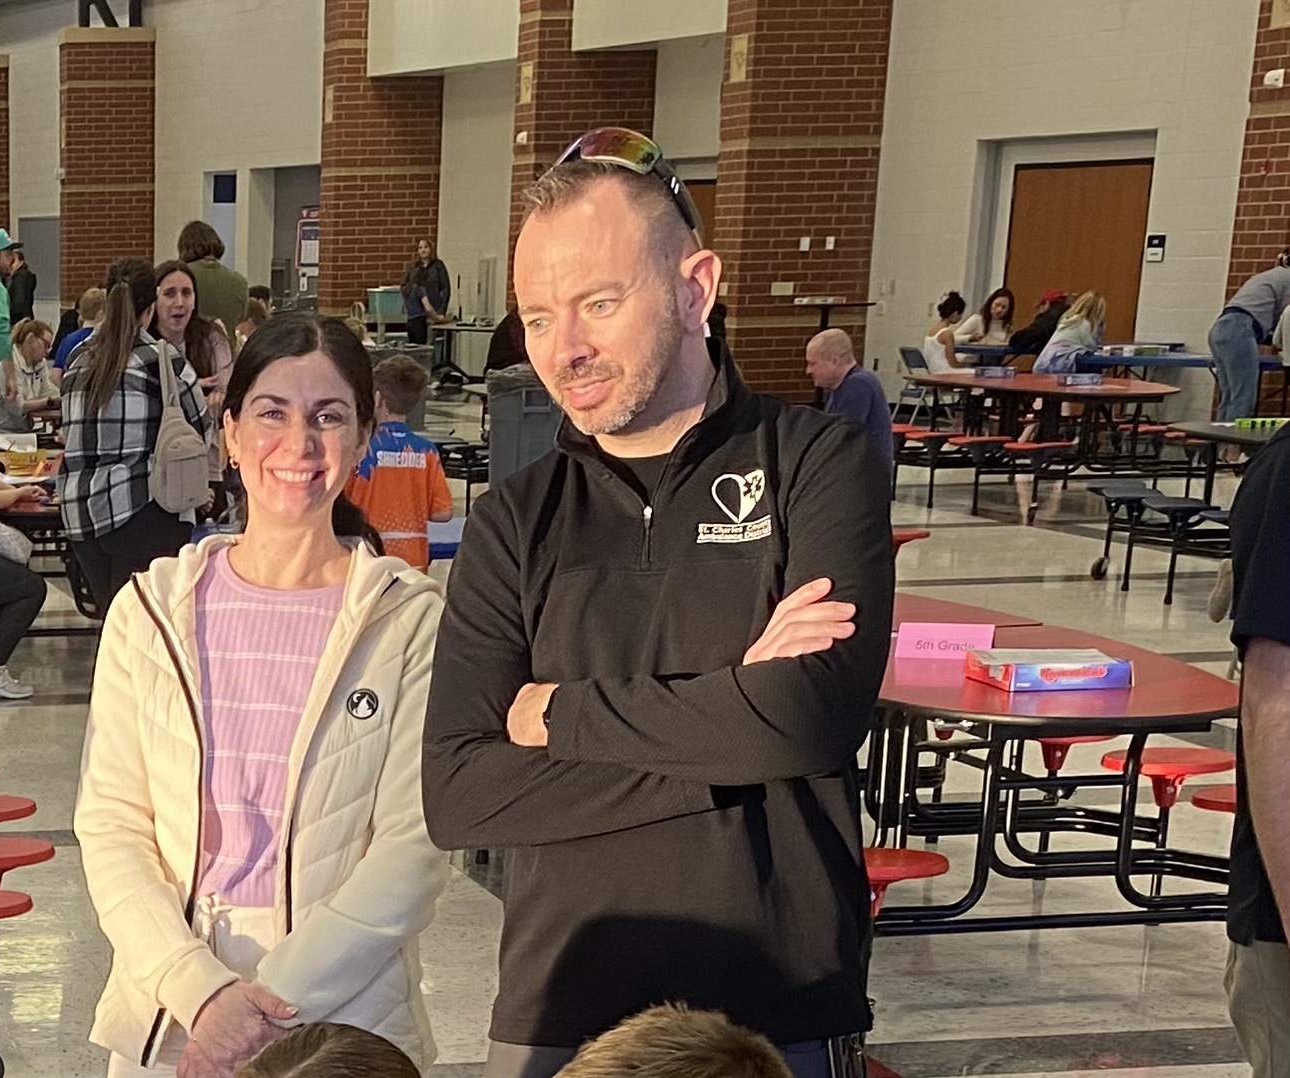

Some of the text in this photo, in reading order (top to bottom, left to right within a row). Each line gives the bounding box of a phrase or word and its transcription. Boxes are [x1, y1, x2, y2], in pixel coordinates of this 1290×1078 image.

[376, 450, 427, 469] SHREDDER
[915, 639, 975, 652] 5th Grade
